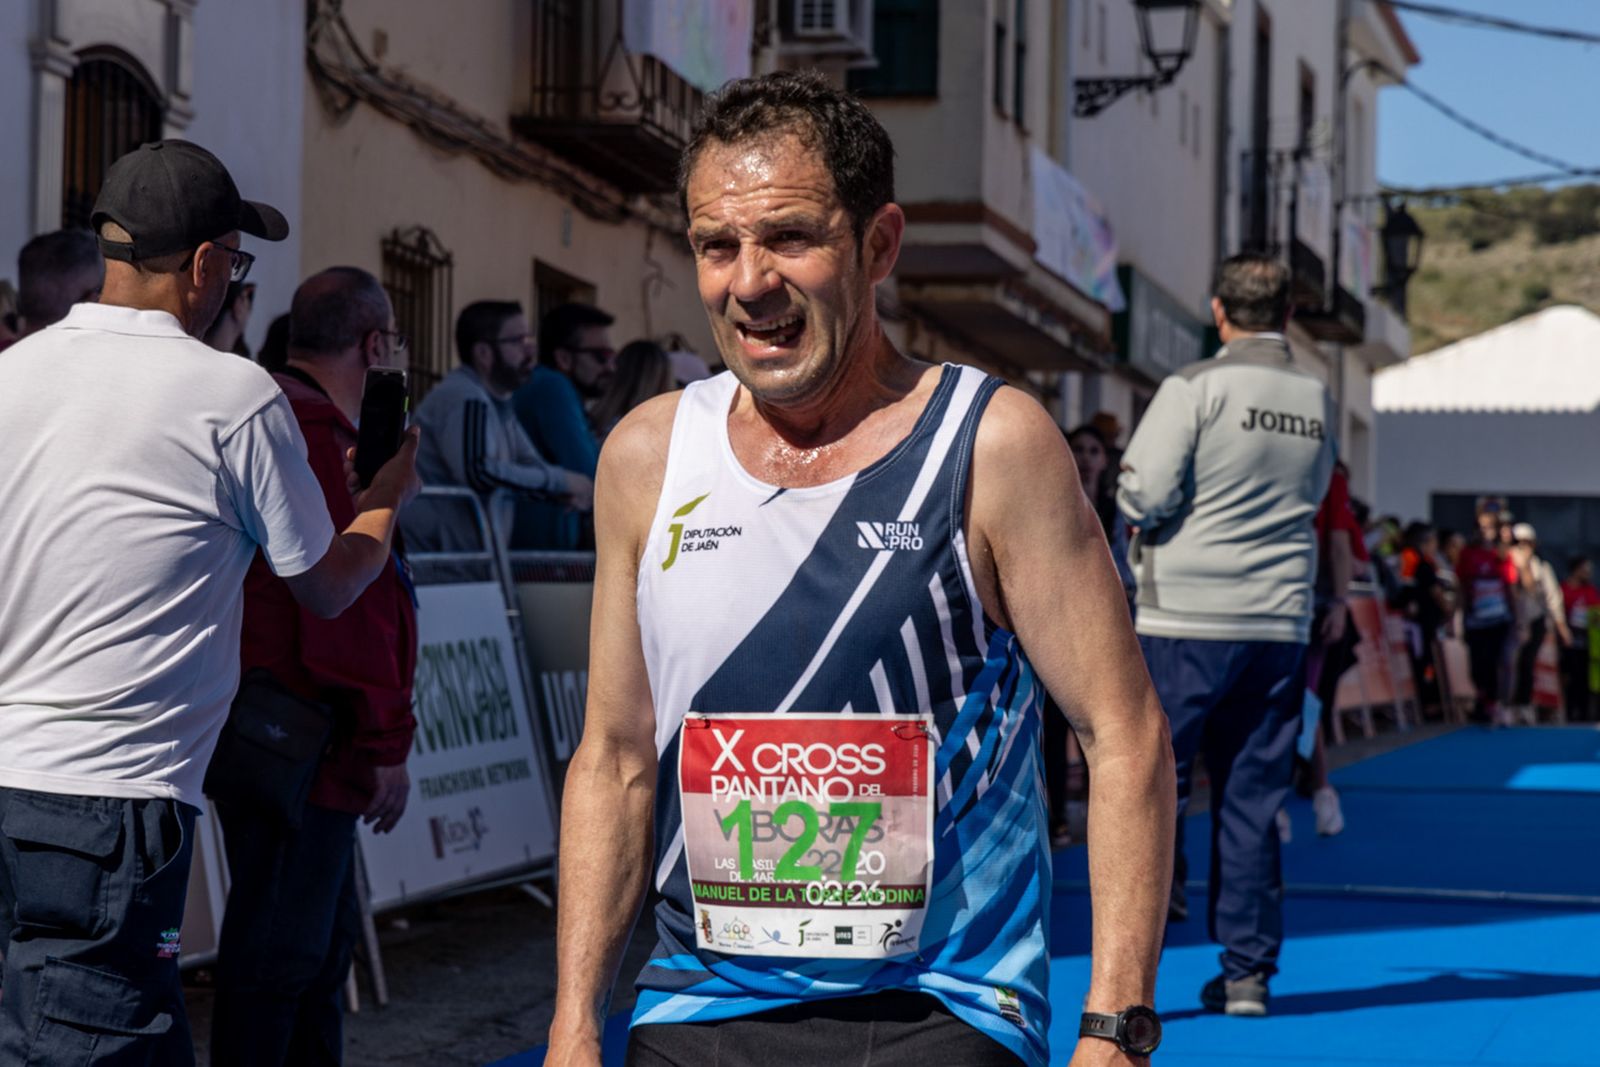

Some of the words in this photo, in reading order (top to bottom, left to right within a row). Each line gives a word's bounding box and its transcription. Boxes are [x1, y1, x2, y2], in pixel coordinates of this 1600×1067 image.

[1241, 407, 1324, 442] Joma
[683, 525, 743, 540] DIPUTACIÓN
[884, 521, 920, 536] RUN
[681, 541, 695, 553] DE
[695, 540, 720, 552] JAÉN
[889, 535, 924, 551] PRO
[711, 729, 745, 772] X
[751, 742, 887, 776] CROSS
[710, 775, 854, 804] PANTANO
[858, 783, 886, 797] DEL
[721, 799, 882, 882] 127
[714, 857, 736, 870] LAS
[692, 883, 745, 901] MANUEL
[749, 887, 771, 901] DE
[775, 886, 796, 902] LA
